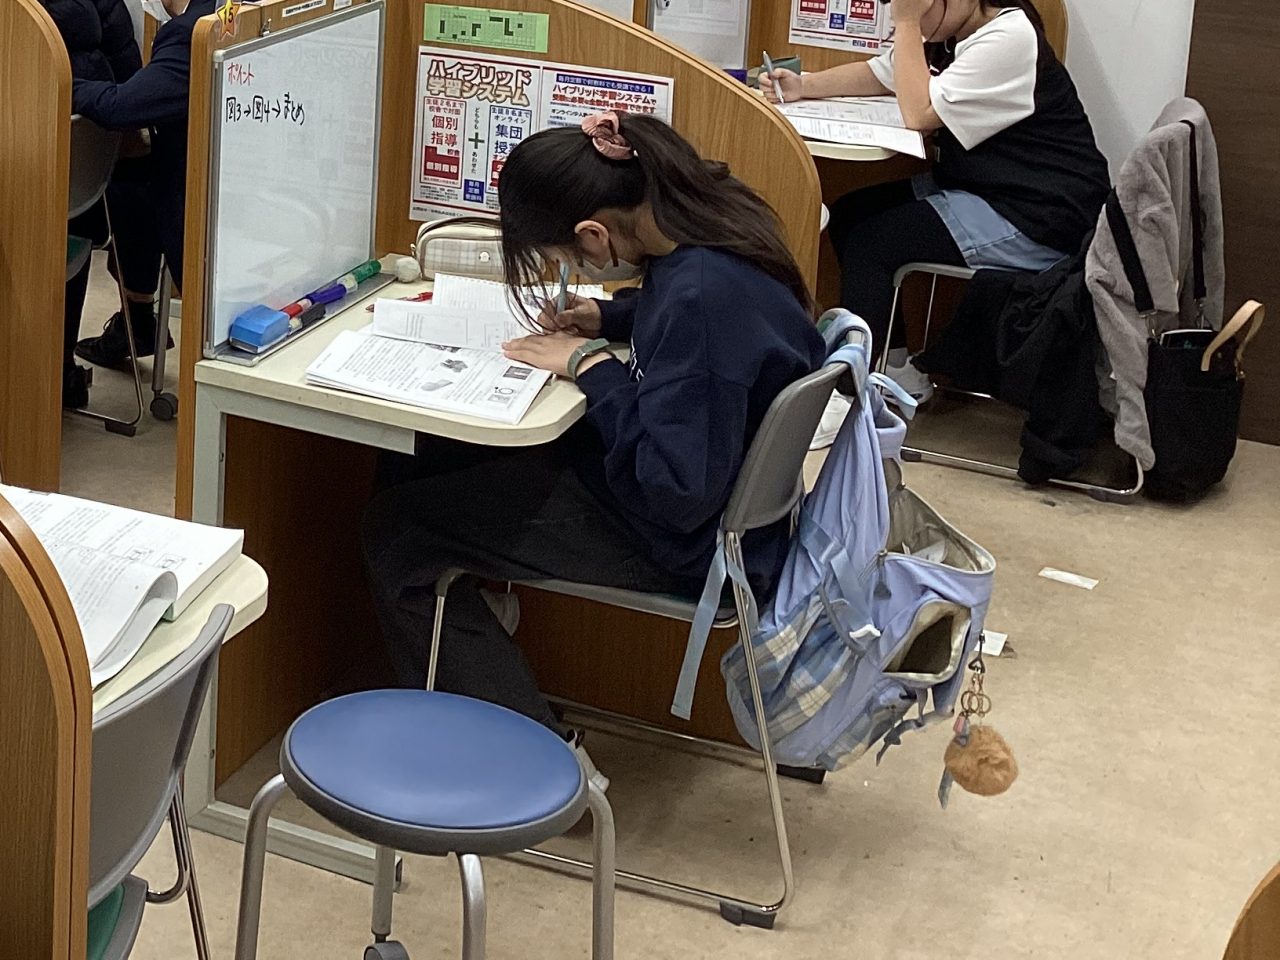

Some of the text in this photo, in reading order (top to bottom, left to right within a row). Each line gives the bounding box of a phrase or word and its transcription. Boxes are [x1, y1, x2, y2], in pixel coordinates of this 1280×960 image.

[224, 7, 233, 24] 15
[429, 60, 531, 89] ハイブリッド
[427, 75, 531, 107] 学習システム
[432, 116, 458, 131] 個別
[431, 131, 458, 147] 指導
[495, 124, 523, 140] 集団
